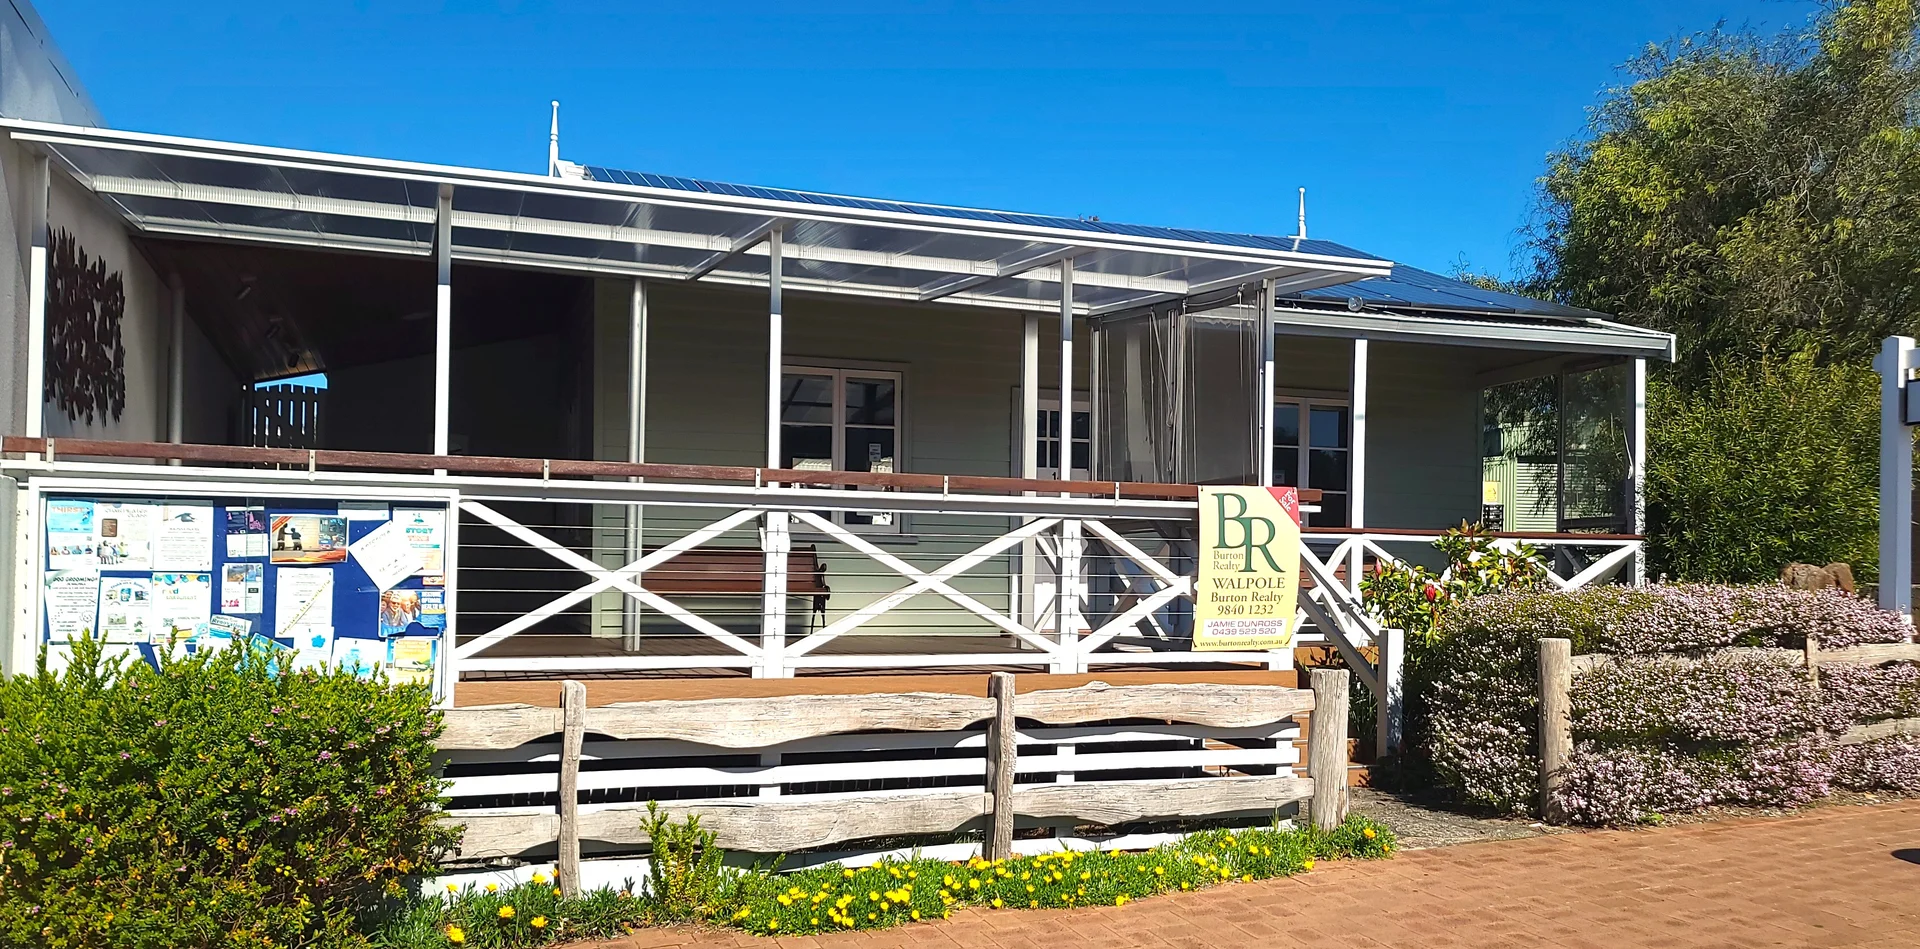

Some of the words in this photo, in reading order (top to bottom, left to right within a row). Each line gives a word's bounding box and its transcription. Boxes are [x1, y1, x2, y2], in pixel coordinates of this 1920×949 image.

[1284, 489, 1297, 504] For
[1278, 496, 1292, 512] Sale
[1211, 492, 1286, 573] BR
[1213, 550, 1244, 560] Burton
[1213, 560, 1241, 572] Realty
[1212, 577, 1286, 590] WALPOLE
[1211, 591, 1248, 603] Burton
[1251, 591, 1284, 605] Realty
[1217, 604, 1244, 616] 9840
[1249, 604, 1274, 615] 1232
[1207, 620, 1235, 628] JAMIE
[1237, 620, 1283, 628] DUNROSS
[1211, 628, 1237, 636] 0439
[1239, 628, 1257, 636] 529
[1199, 639, 1283, 648] www.burtonrealty.com.au
